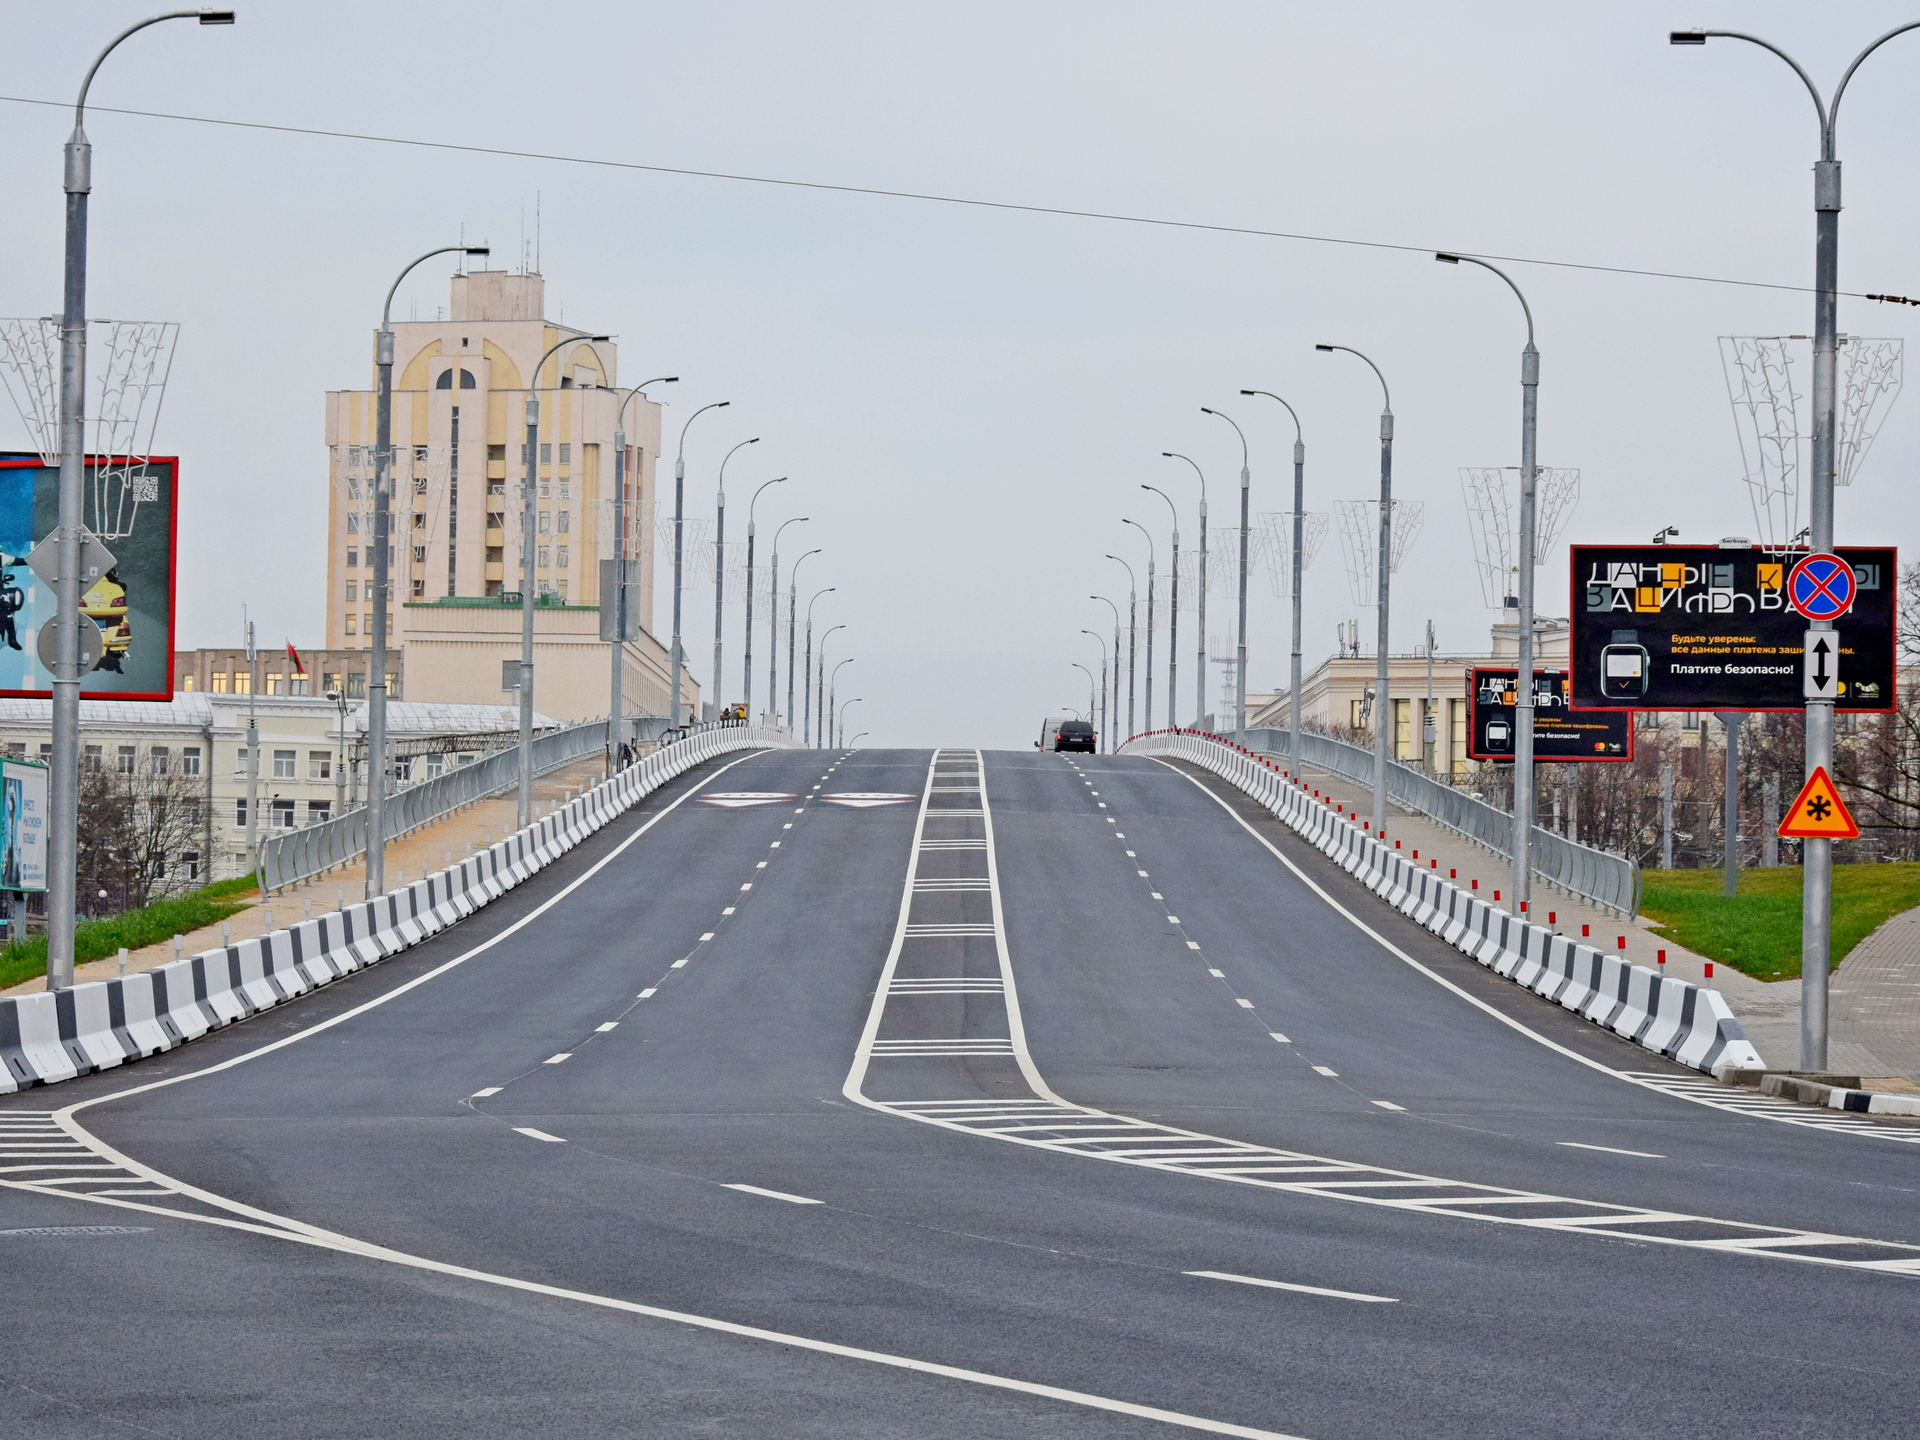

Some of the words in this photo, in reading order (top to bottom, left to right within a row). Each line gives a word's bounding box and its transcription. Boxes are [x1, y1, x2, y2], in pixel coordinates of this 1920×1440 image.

[1586, 587, 1853, 613] ЗАШИФРОВ
[1671, 634, 1706, 644] Будьте
[1708, 635, 1757, 645] уверены:
[1671, 646, 1689, 654] все
[1691, 646, 1731, 655] данные
[1733, 646, 1776, 655] платежа
[1779, 646, 1855, 655] зашины.
[1670, 664, 1722, 674] Платите
[1725, 663, 1794, 675] безопасно!
[1546, 732, 1581, 740] безопасно!
